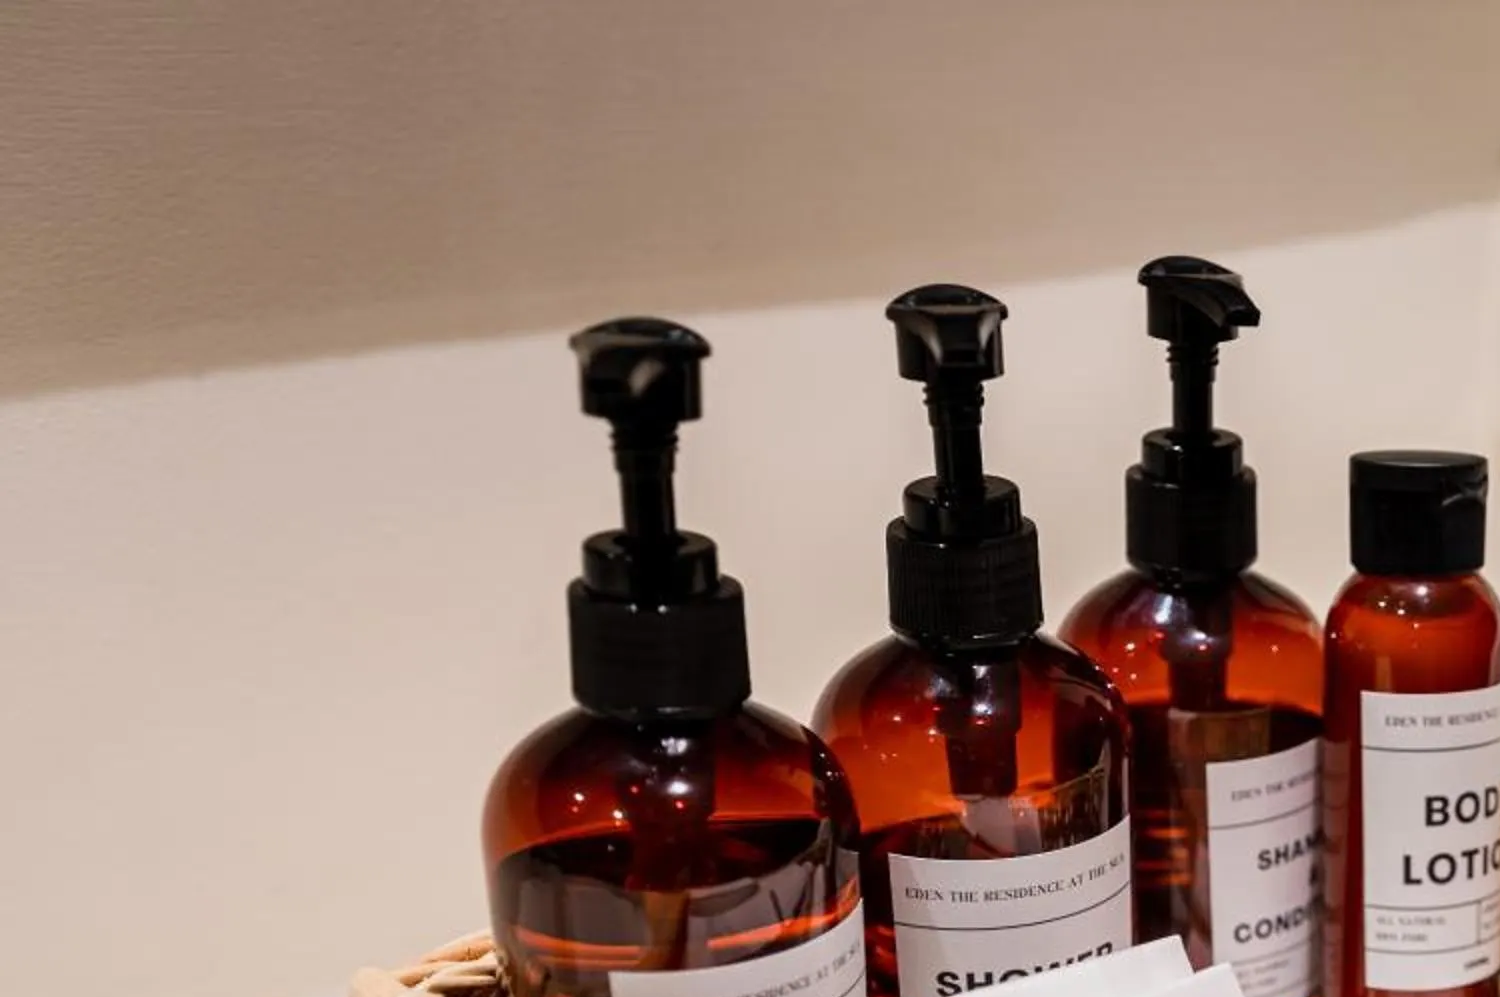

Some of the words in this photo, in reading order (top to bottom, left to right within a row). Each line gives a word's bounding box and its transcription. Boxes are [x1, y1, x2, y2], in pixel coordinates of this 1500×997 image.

[905, 886, 944, 901] EDEN
[949, 890, 978, 903] THE
[983, 879, 1064, 902] RESIDENCE
[1067, 873, 1084, 888] AT
